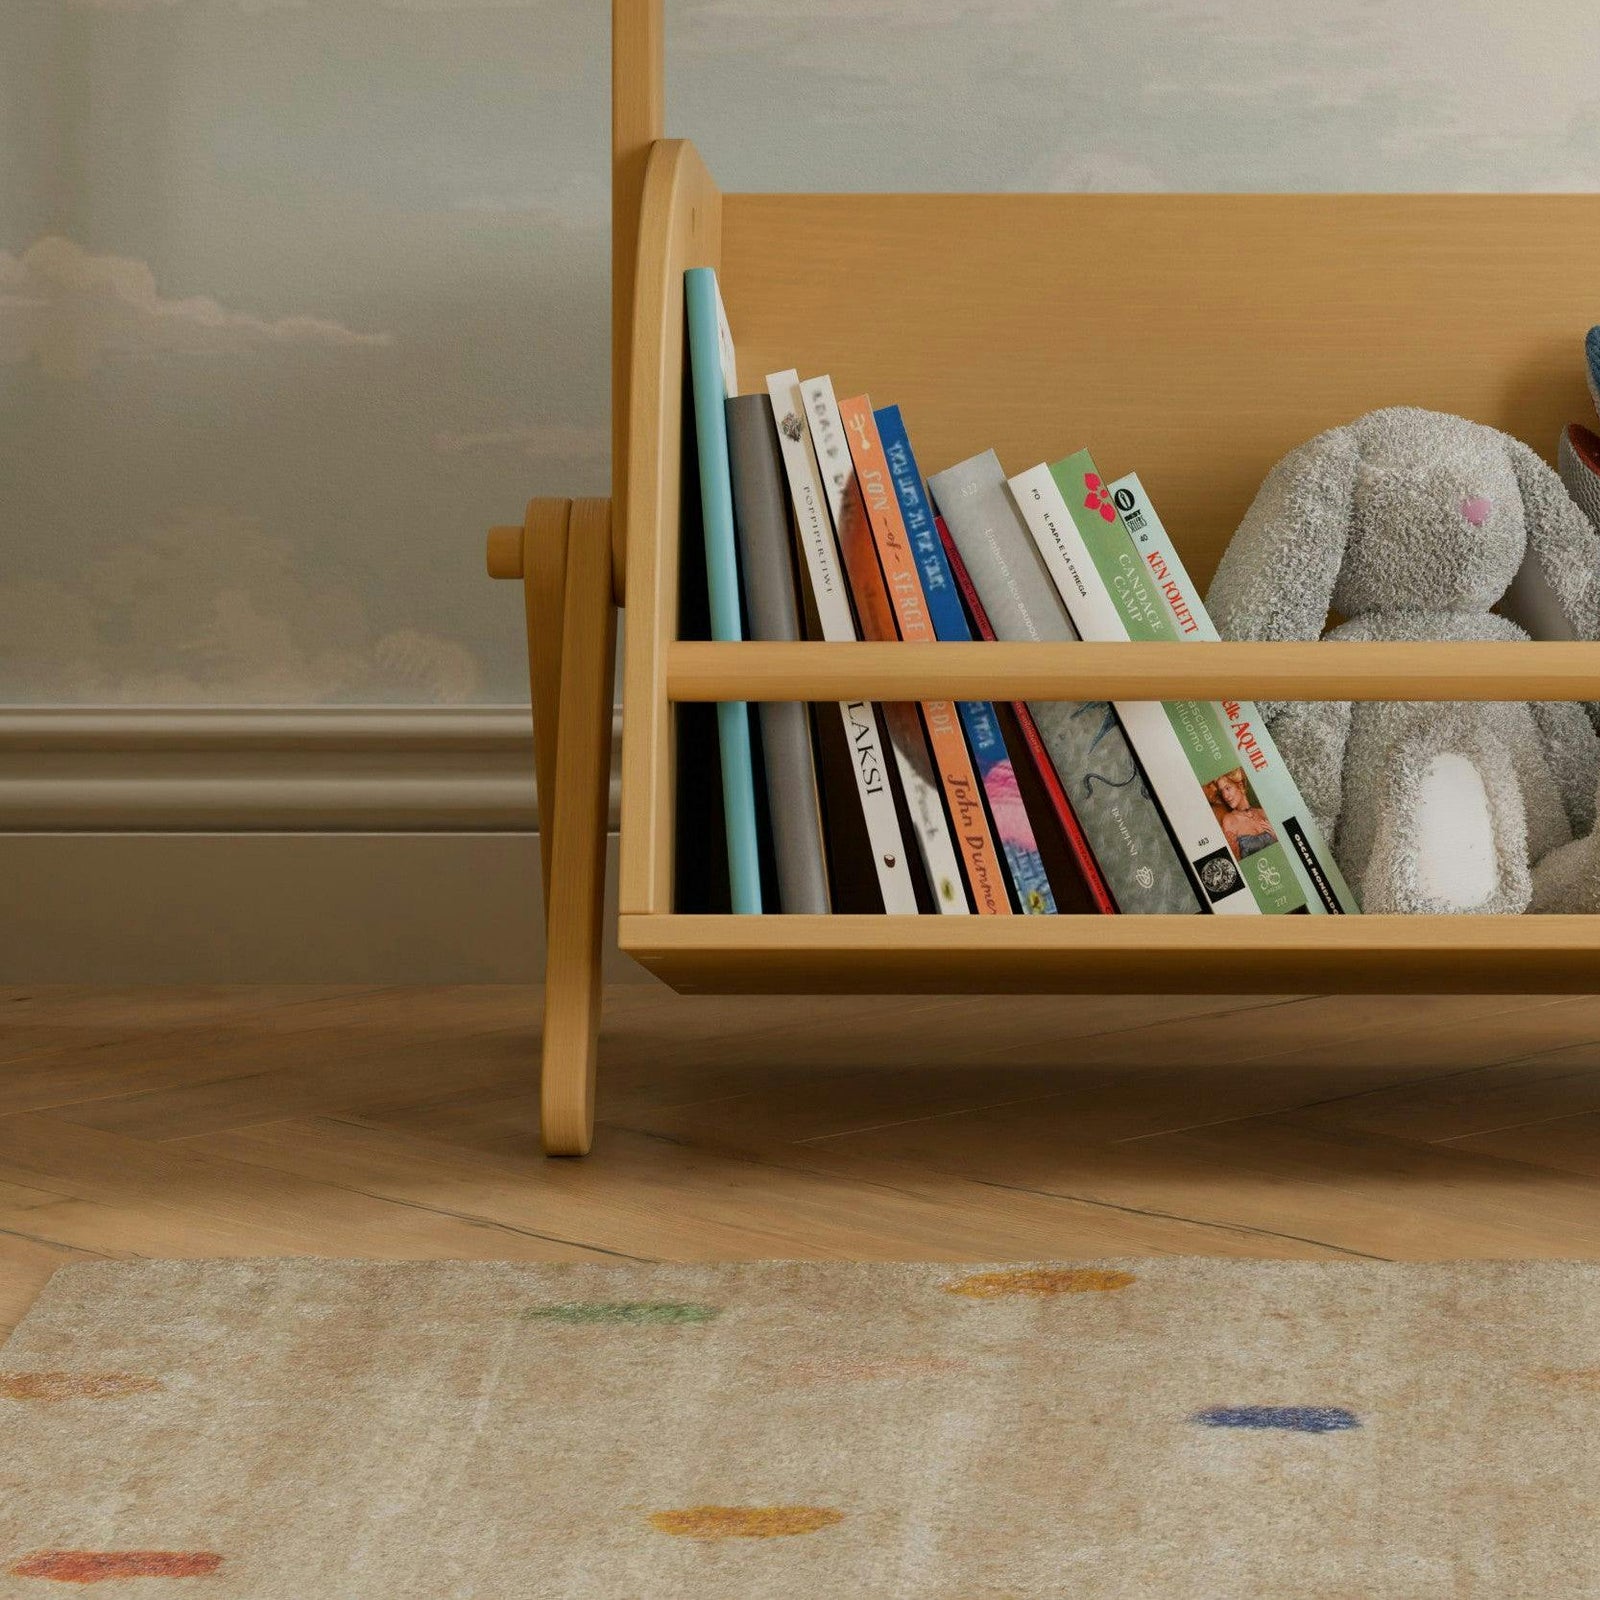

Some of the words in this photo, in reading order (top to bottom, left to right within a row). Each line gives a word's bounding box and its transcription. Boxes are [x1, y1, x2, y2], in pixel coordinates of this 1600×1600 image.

[1031, 488, 1041, 501] FO
[985, 528, 1010, 578] Umberto
[1007, 578, 1020, 601] Eco
[1043, 512, 1051, 522] IL
[1048, 522, 1062, 546] PAPA
[1062, 552, 1072, 565] LA
[1069, 565, 1087, 597] STREGA
[893, 571, 927, 634] SERGE
[1113, 575, 1143, 622] CAMP
[1118, 553, 1164, 634] CANDACE
[1146, 551, 1169, 581] KEN
[1162, 581, 1199, 635] FOLLETT
[847, 702, 883, 797] LAKSI
[1220, 701, 1241, 722] elle
[1231, 720, 1268, 773] AQUILE
[946, 773, 975, 828] John
[1112, 807, 1138, 857] BOMPIANI
[1293, 832, 1314, 866] OSCAR
